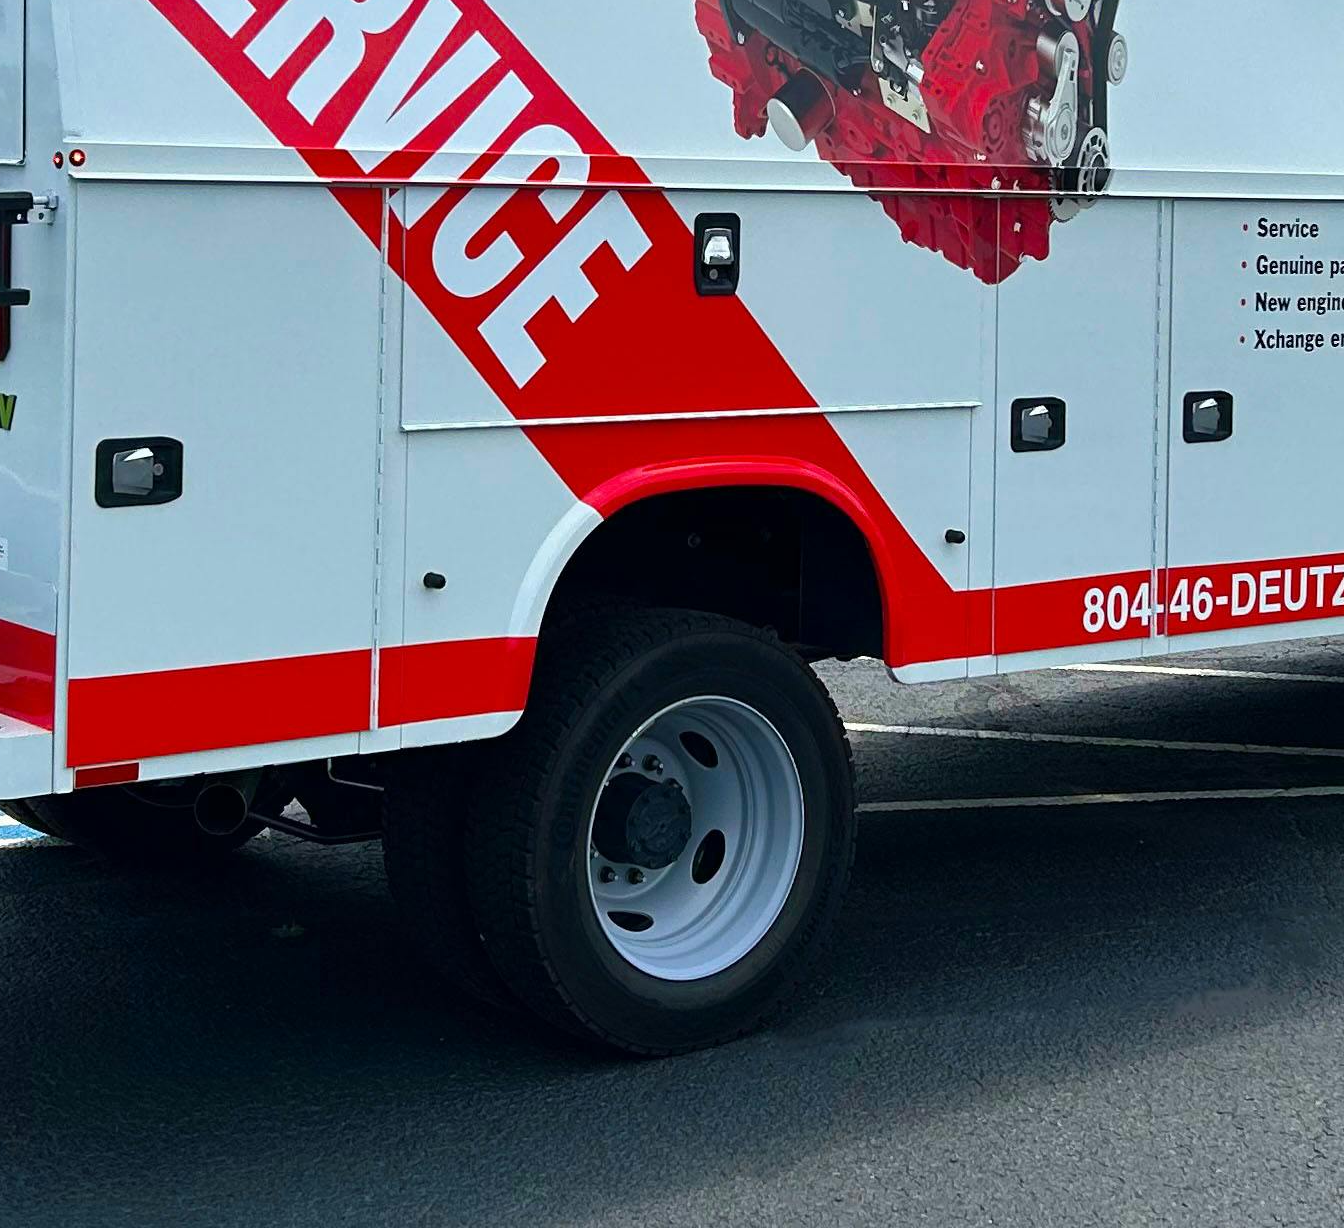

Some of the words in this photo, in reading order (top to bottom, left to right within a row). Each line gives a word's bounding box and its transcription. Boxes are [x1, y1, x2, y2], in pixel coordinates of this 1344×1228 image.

[1256, 217, 1320, 239] Service
[1255, 254, 1325, 275] Genuine
[1255, 292, 1291, 312] New
[1253, 328, 1325, 352] Xchange
